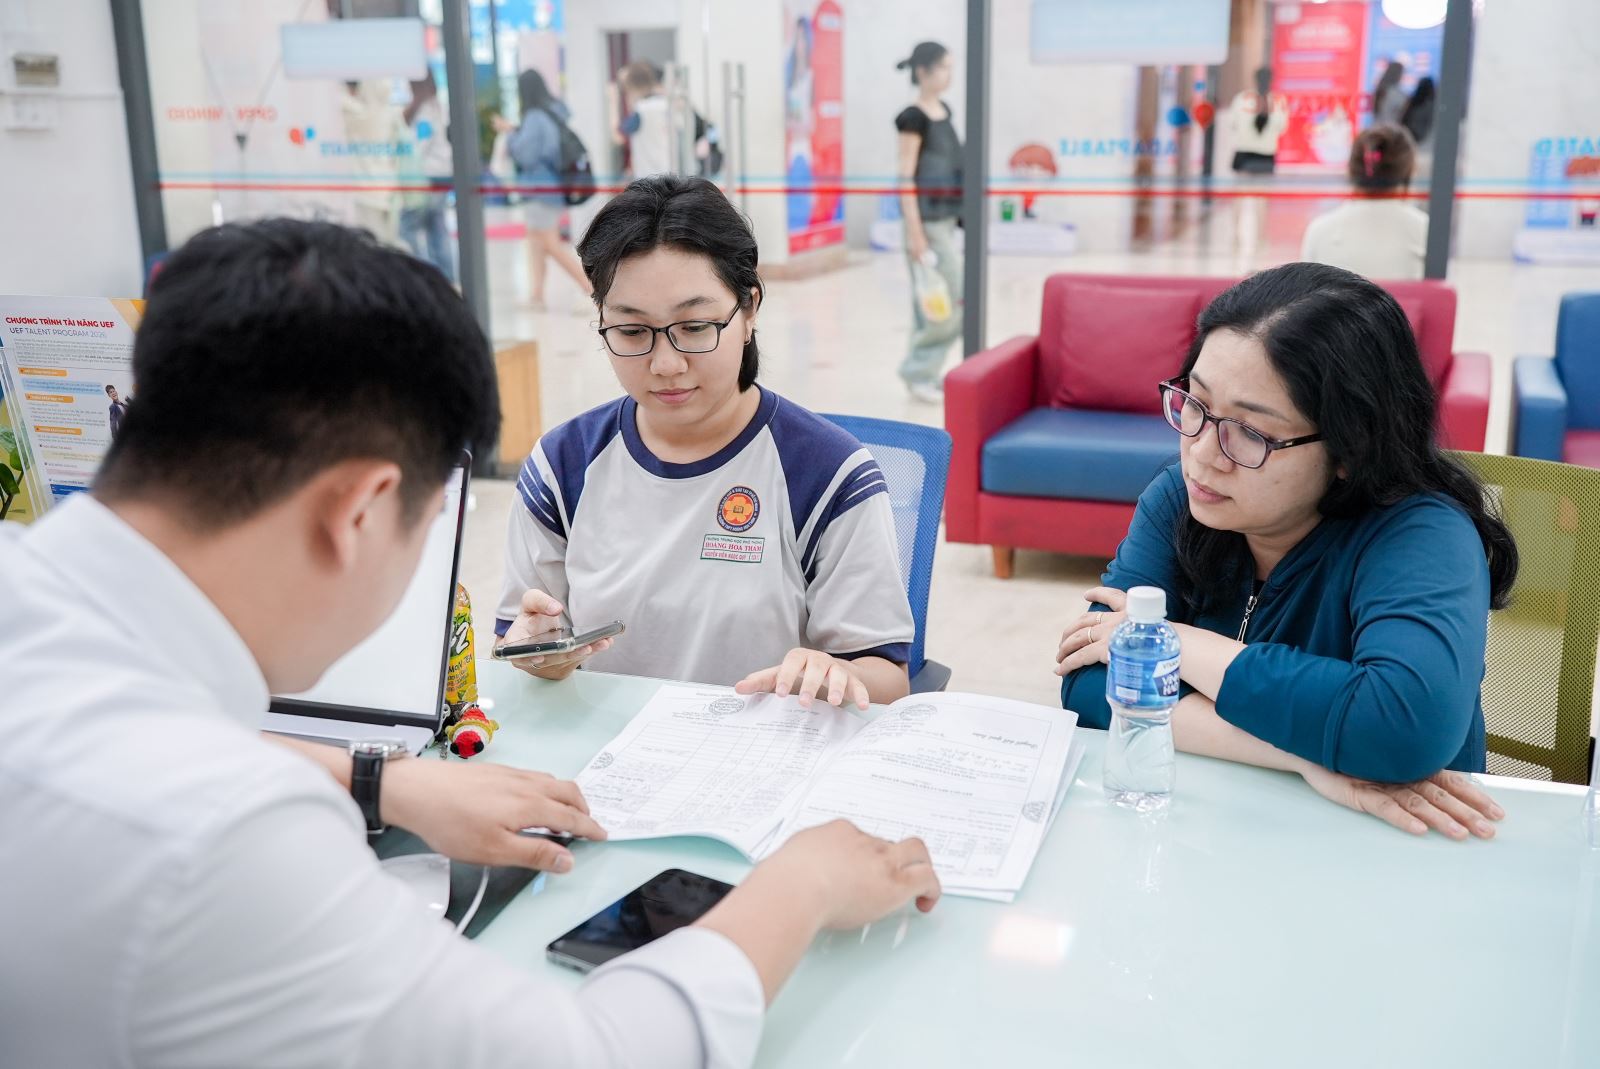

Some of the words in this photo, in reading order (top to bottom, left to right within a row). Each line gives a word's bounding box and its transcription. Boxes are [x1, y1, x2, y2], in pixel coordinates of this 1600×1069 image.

[5, 316, 38, 325] CHƯƠNG
[38, 316, 62, 326] TRÌNH
[62, 317, 76, 327] TÀI
[76, 318, 99, 328] NĂNG
[24, 327, 52, 335] TALENT
[52, 329, 89, 337] PROGRAM
